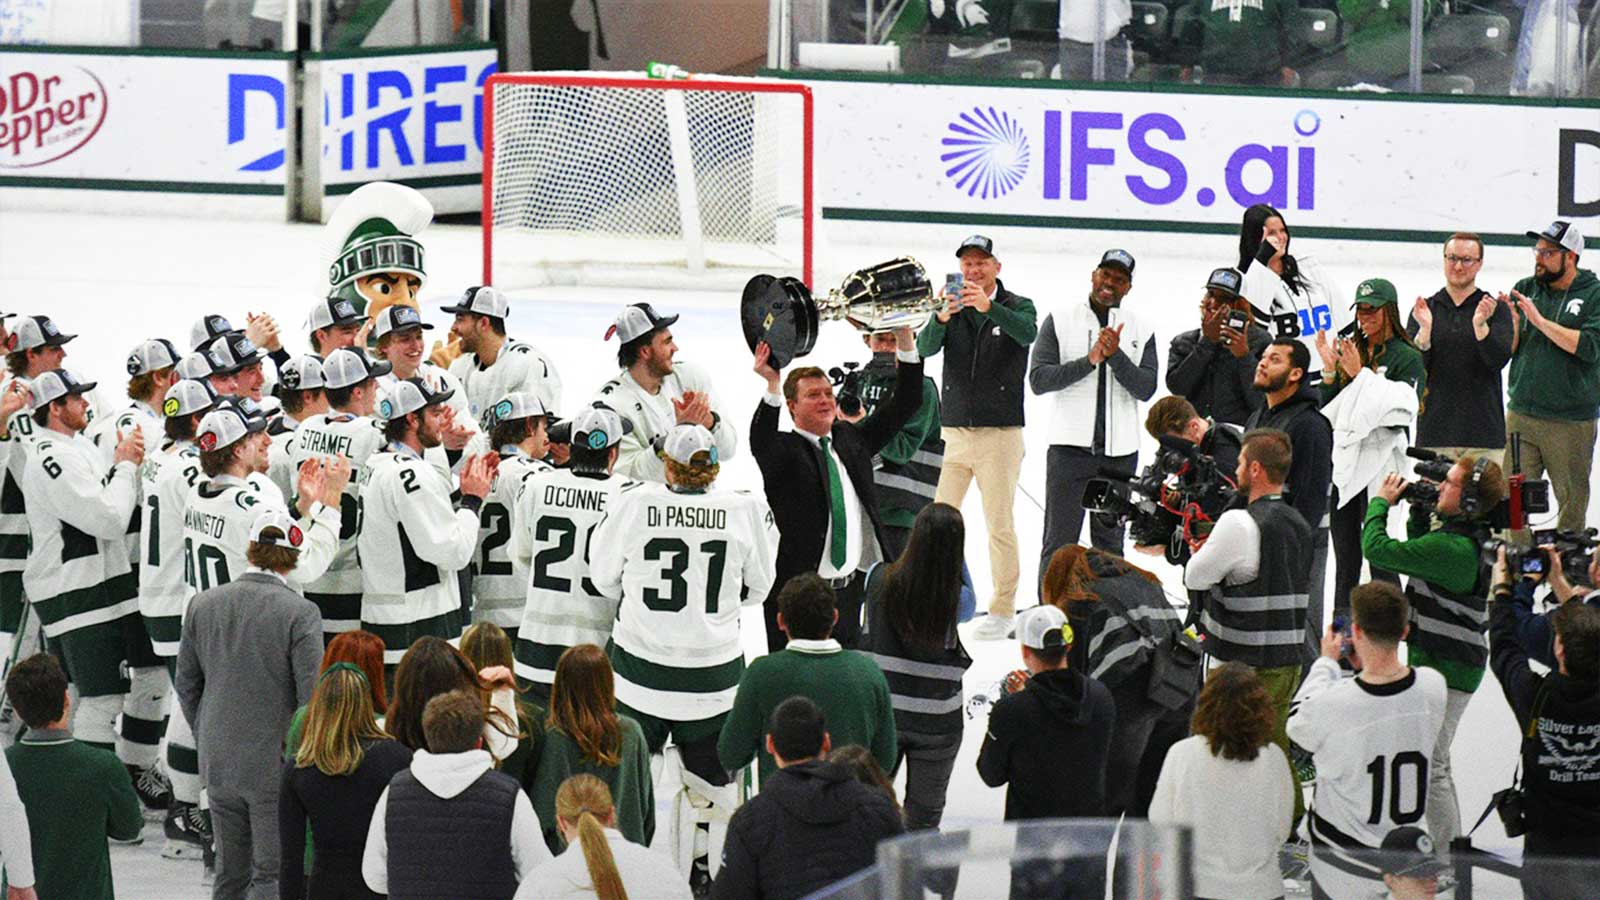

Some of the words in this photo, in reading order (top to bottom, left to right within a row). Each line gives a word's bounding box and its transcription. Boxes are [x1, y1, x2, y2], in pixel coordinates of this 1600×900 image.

[9, 72, 61, 114] Dr
[1043, 108, 1320, 211] IFS.ai
[43, 456, 62, 480] 6
[400, 468, 420, 494] 2
[666, 506, 727, 530] PASQUO
[643, 538, 728, 613] 31
[1538, 717, 1575, 734] Silver
[1366, 751, 1428, 825] 10
[1549, 769, 1574, 782] Drill
